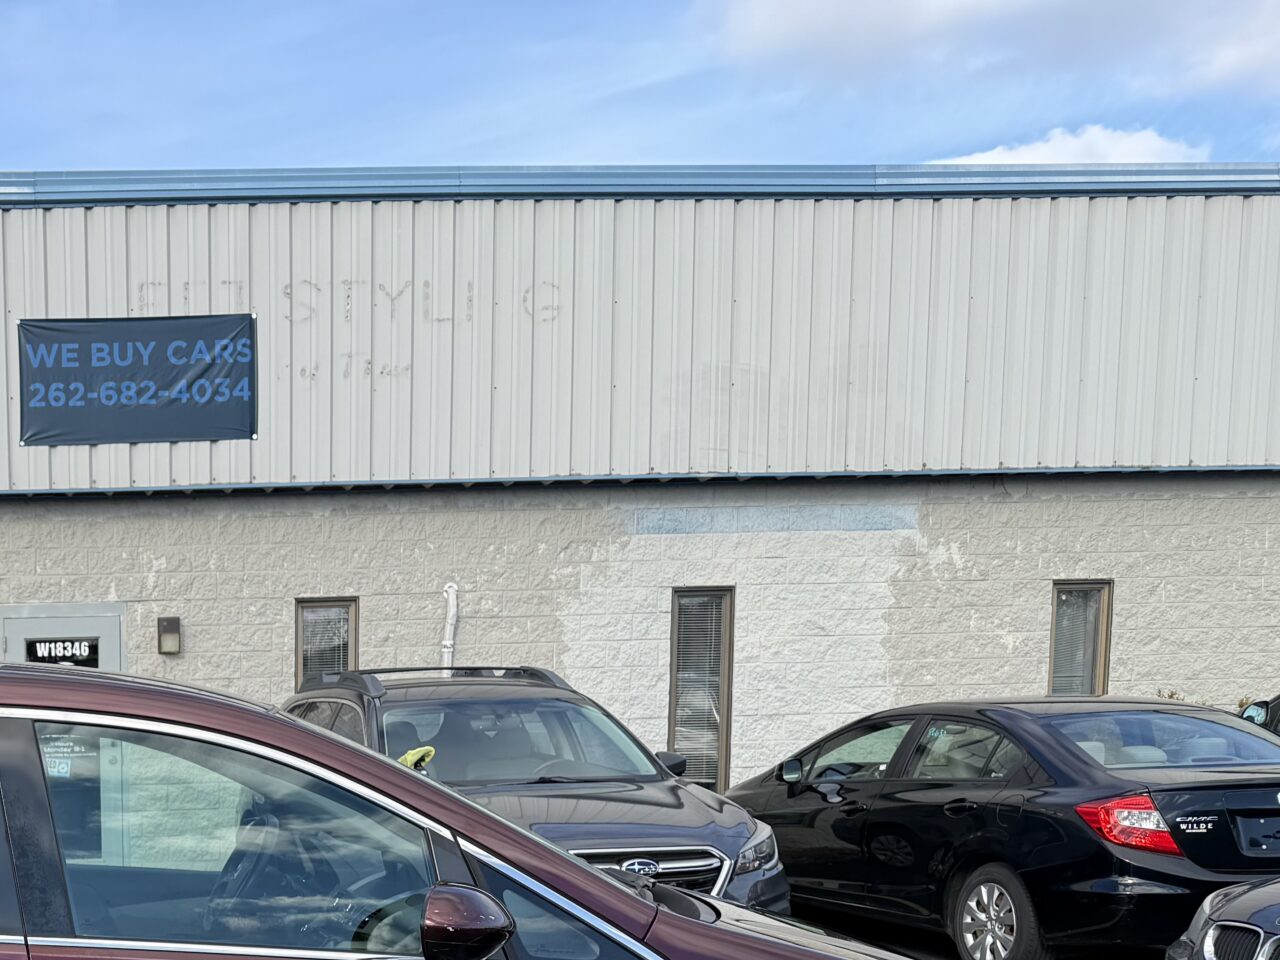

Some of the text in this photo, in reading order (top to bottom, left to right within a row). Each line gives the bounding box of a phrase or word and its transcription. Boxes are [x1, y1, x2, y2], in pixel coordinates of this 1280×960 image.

[282, 279, 562, 323] STYLIG
[25, 338, 252, 368] WE BUY CARS
[28, 377, 252, 408] 262-682-4034
[36, 641, 89, 657] W18346
